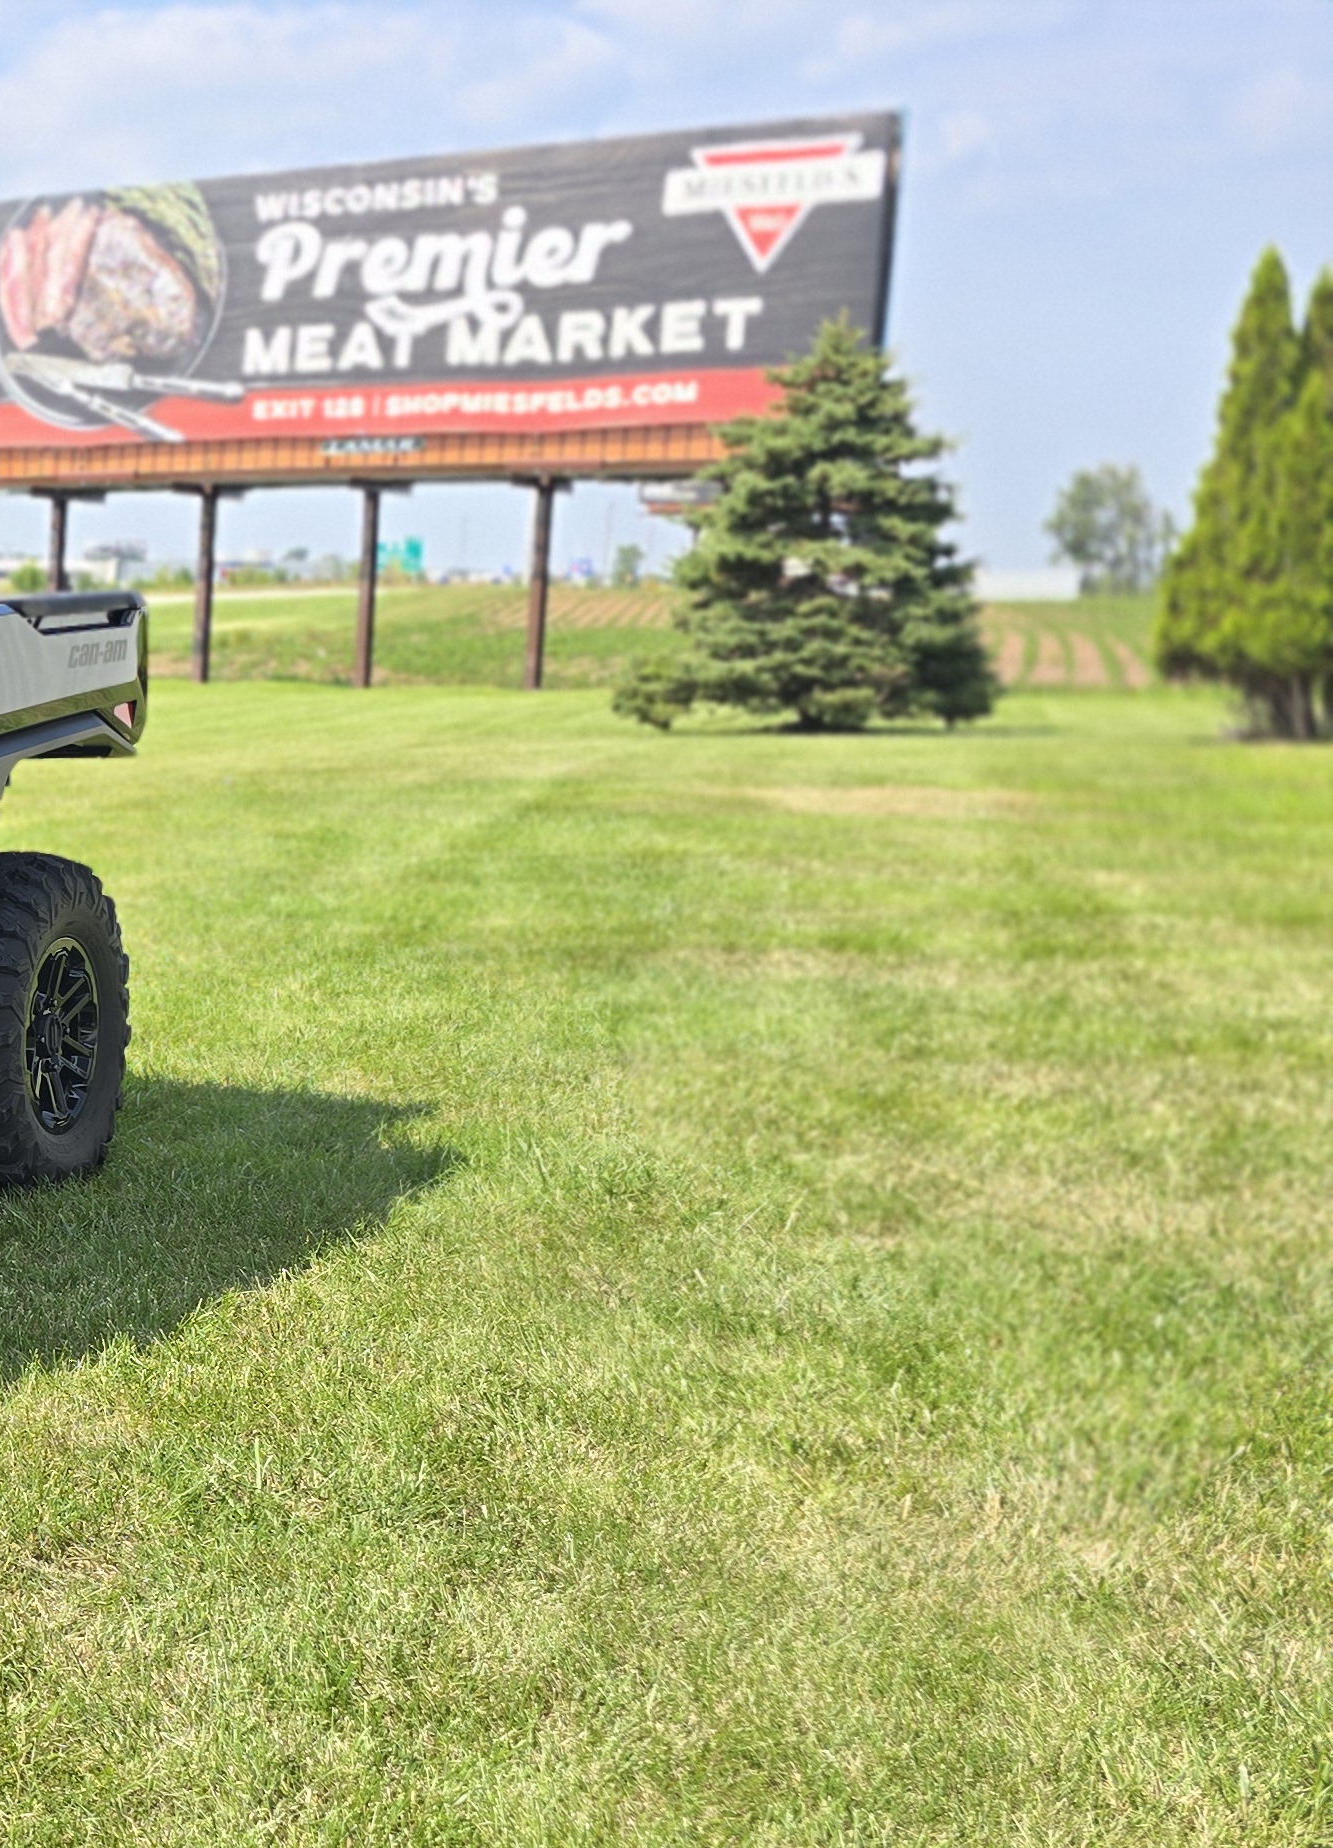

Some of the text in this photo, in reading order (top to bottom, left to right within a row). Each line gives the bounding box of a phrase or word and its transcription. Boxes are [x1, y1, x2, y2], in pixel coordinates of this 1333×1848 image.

[255, 174, 499, 223] WISCONSIN'S
[255, 206, 631, 334] Premier
[242, 298, 764, 376] MEAT MARKET
[253, 398, 315, 420] EXIT
[385, 382, 699, 417] SHOPMIESFELDS.COM
[68, 638, 128, 669] can-am
